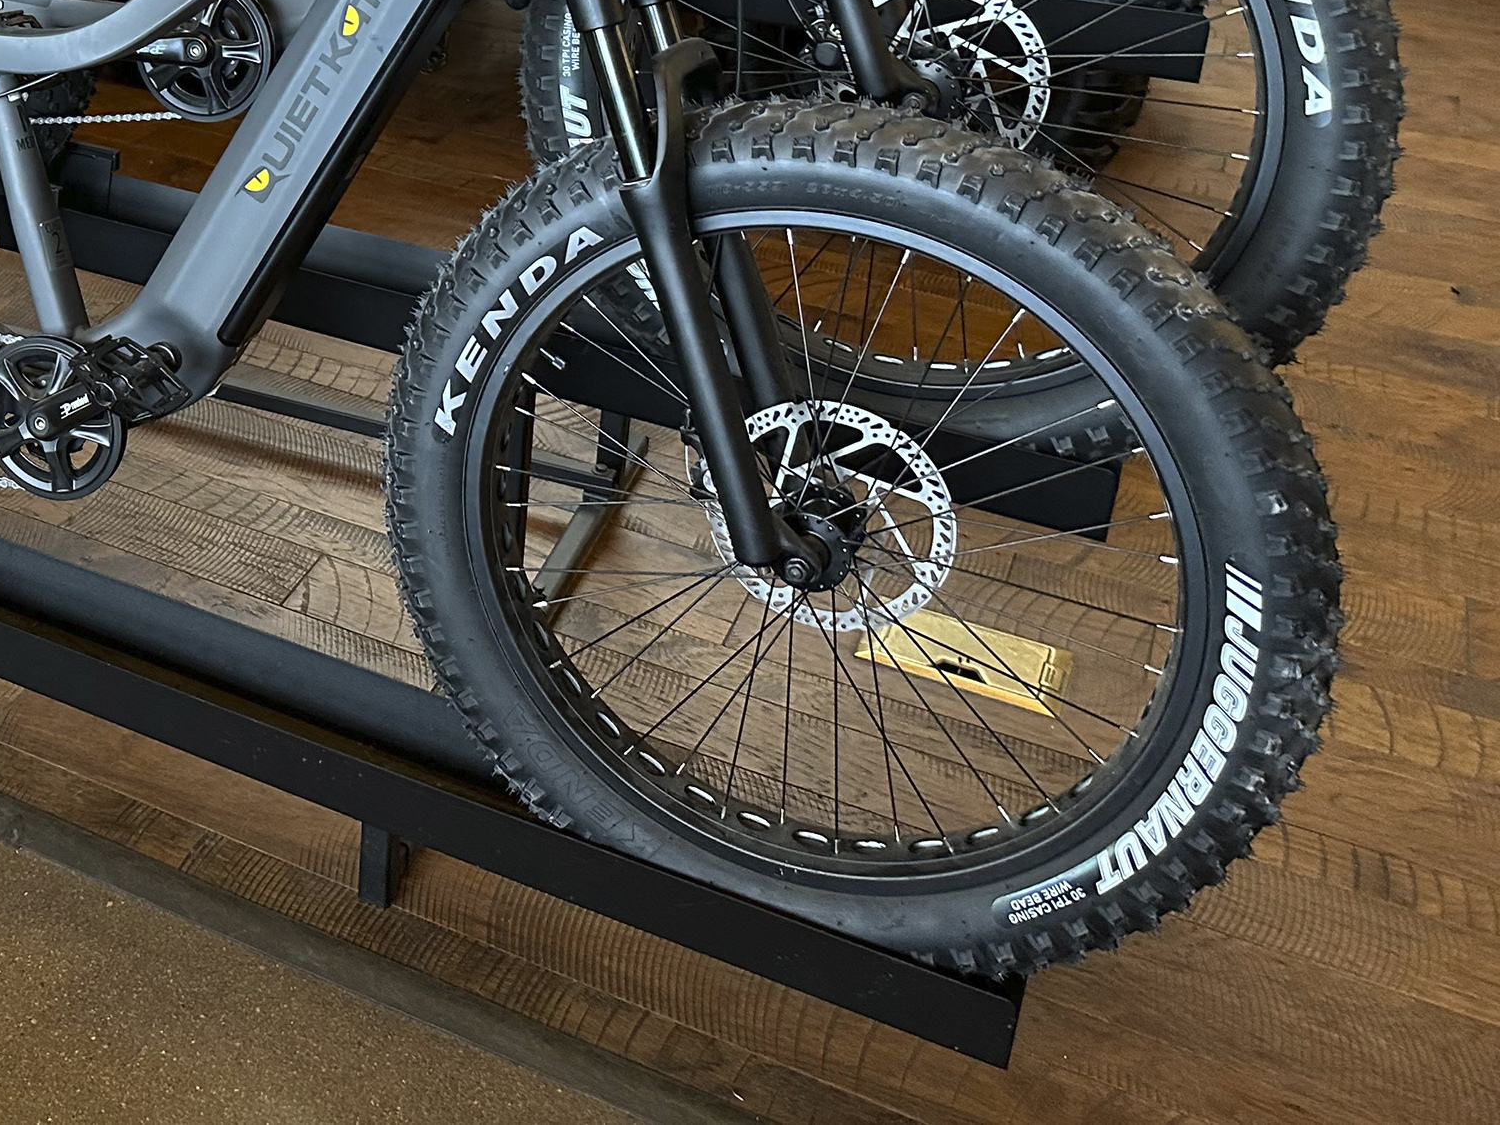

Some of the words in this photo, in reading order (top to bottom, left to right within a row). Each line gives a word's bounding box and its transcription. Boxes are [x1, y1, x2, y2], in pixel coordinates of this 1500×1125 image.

[562, 49, 571, 66] TPI
[571, 46, 580, 71] WIRE
[562, 67, 571, 77] 30
[434, 226, 604, 437] KENDA
[1095, 614, 1260, 895] JUGGERNAUT
[1040, 880, 1073, 900] WIRE
[1069, 887, 1087, 901] 30
[1010, 892, 1043, 911] BEAD
[1050, 894, 1073, 910] TPI
[1008, 902, 1052, 925] CASING
